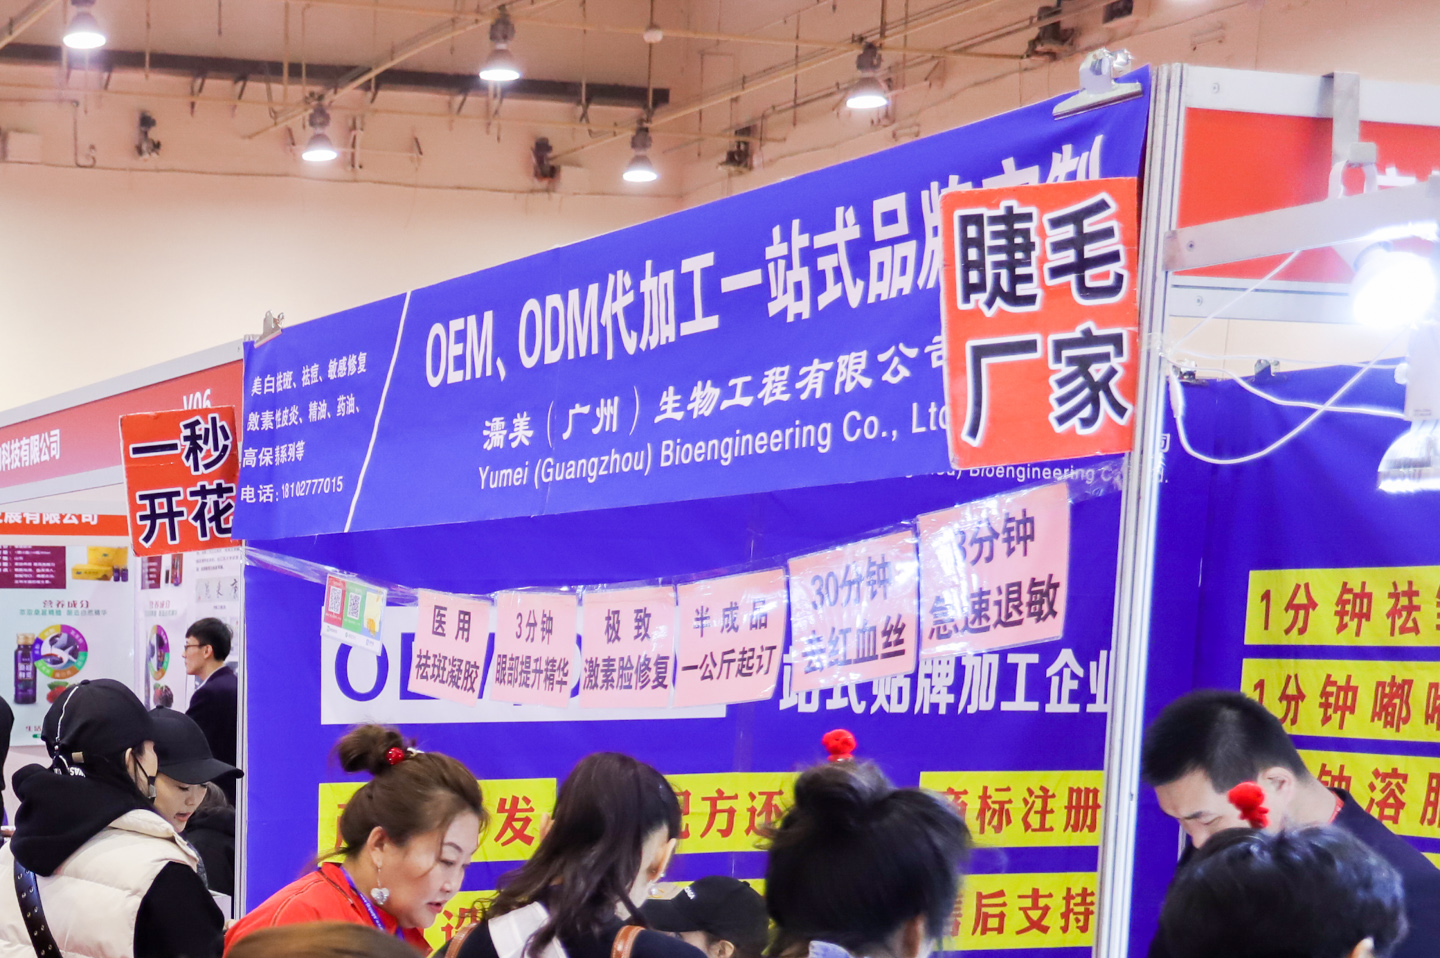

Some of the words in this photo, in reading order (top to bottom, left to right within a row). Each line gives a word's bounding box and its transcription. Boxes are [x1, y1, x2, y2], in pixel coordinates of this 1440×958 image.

[426, 134, 1103, 388] OEM、ODM代加工一站式品
[954, 191, 1127, 314] 睫毛
[962, 323, 1131, 449] 厂家
[128, 415, 233, 476] 一秒
[479, 464, 530, 490] Yumei
[534, 444, 653, 490] (Guangzhou)
[660, 419, 832, 468] Bioengineering
[842, 407, 898, 447] Co.,
[136, 481, 236, 547] 开花
[809, 553, 894, 612] 30分钟
[927, 573, 1062, 643] 急速退敏
[1259, 580, 1440, 638] 1分钟祛
[431, 604, 472, 644] 医用
[514, 608, 554, 645] 3分钟
[603, 606, 653, 645] 极致
[691, 597, 770, 639] 半成品
[801, 613, 908, 676] 去红血丝
[414, 648, 481, 695] 祛斑凝胶
[494, 653, 570, 695] 眼部提升精华
[582, 652, 672, 693] 激素脸修复
[680, 643, 779, 684] 一公斤起订
